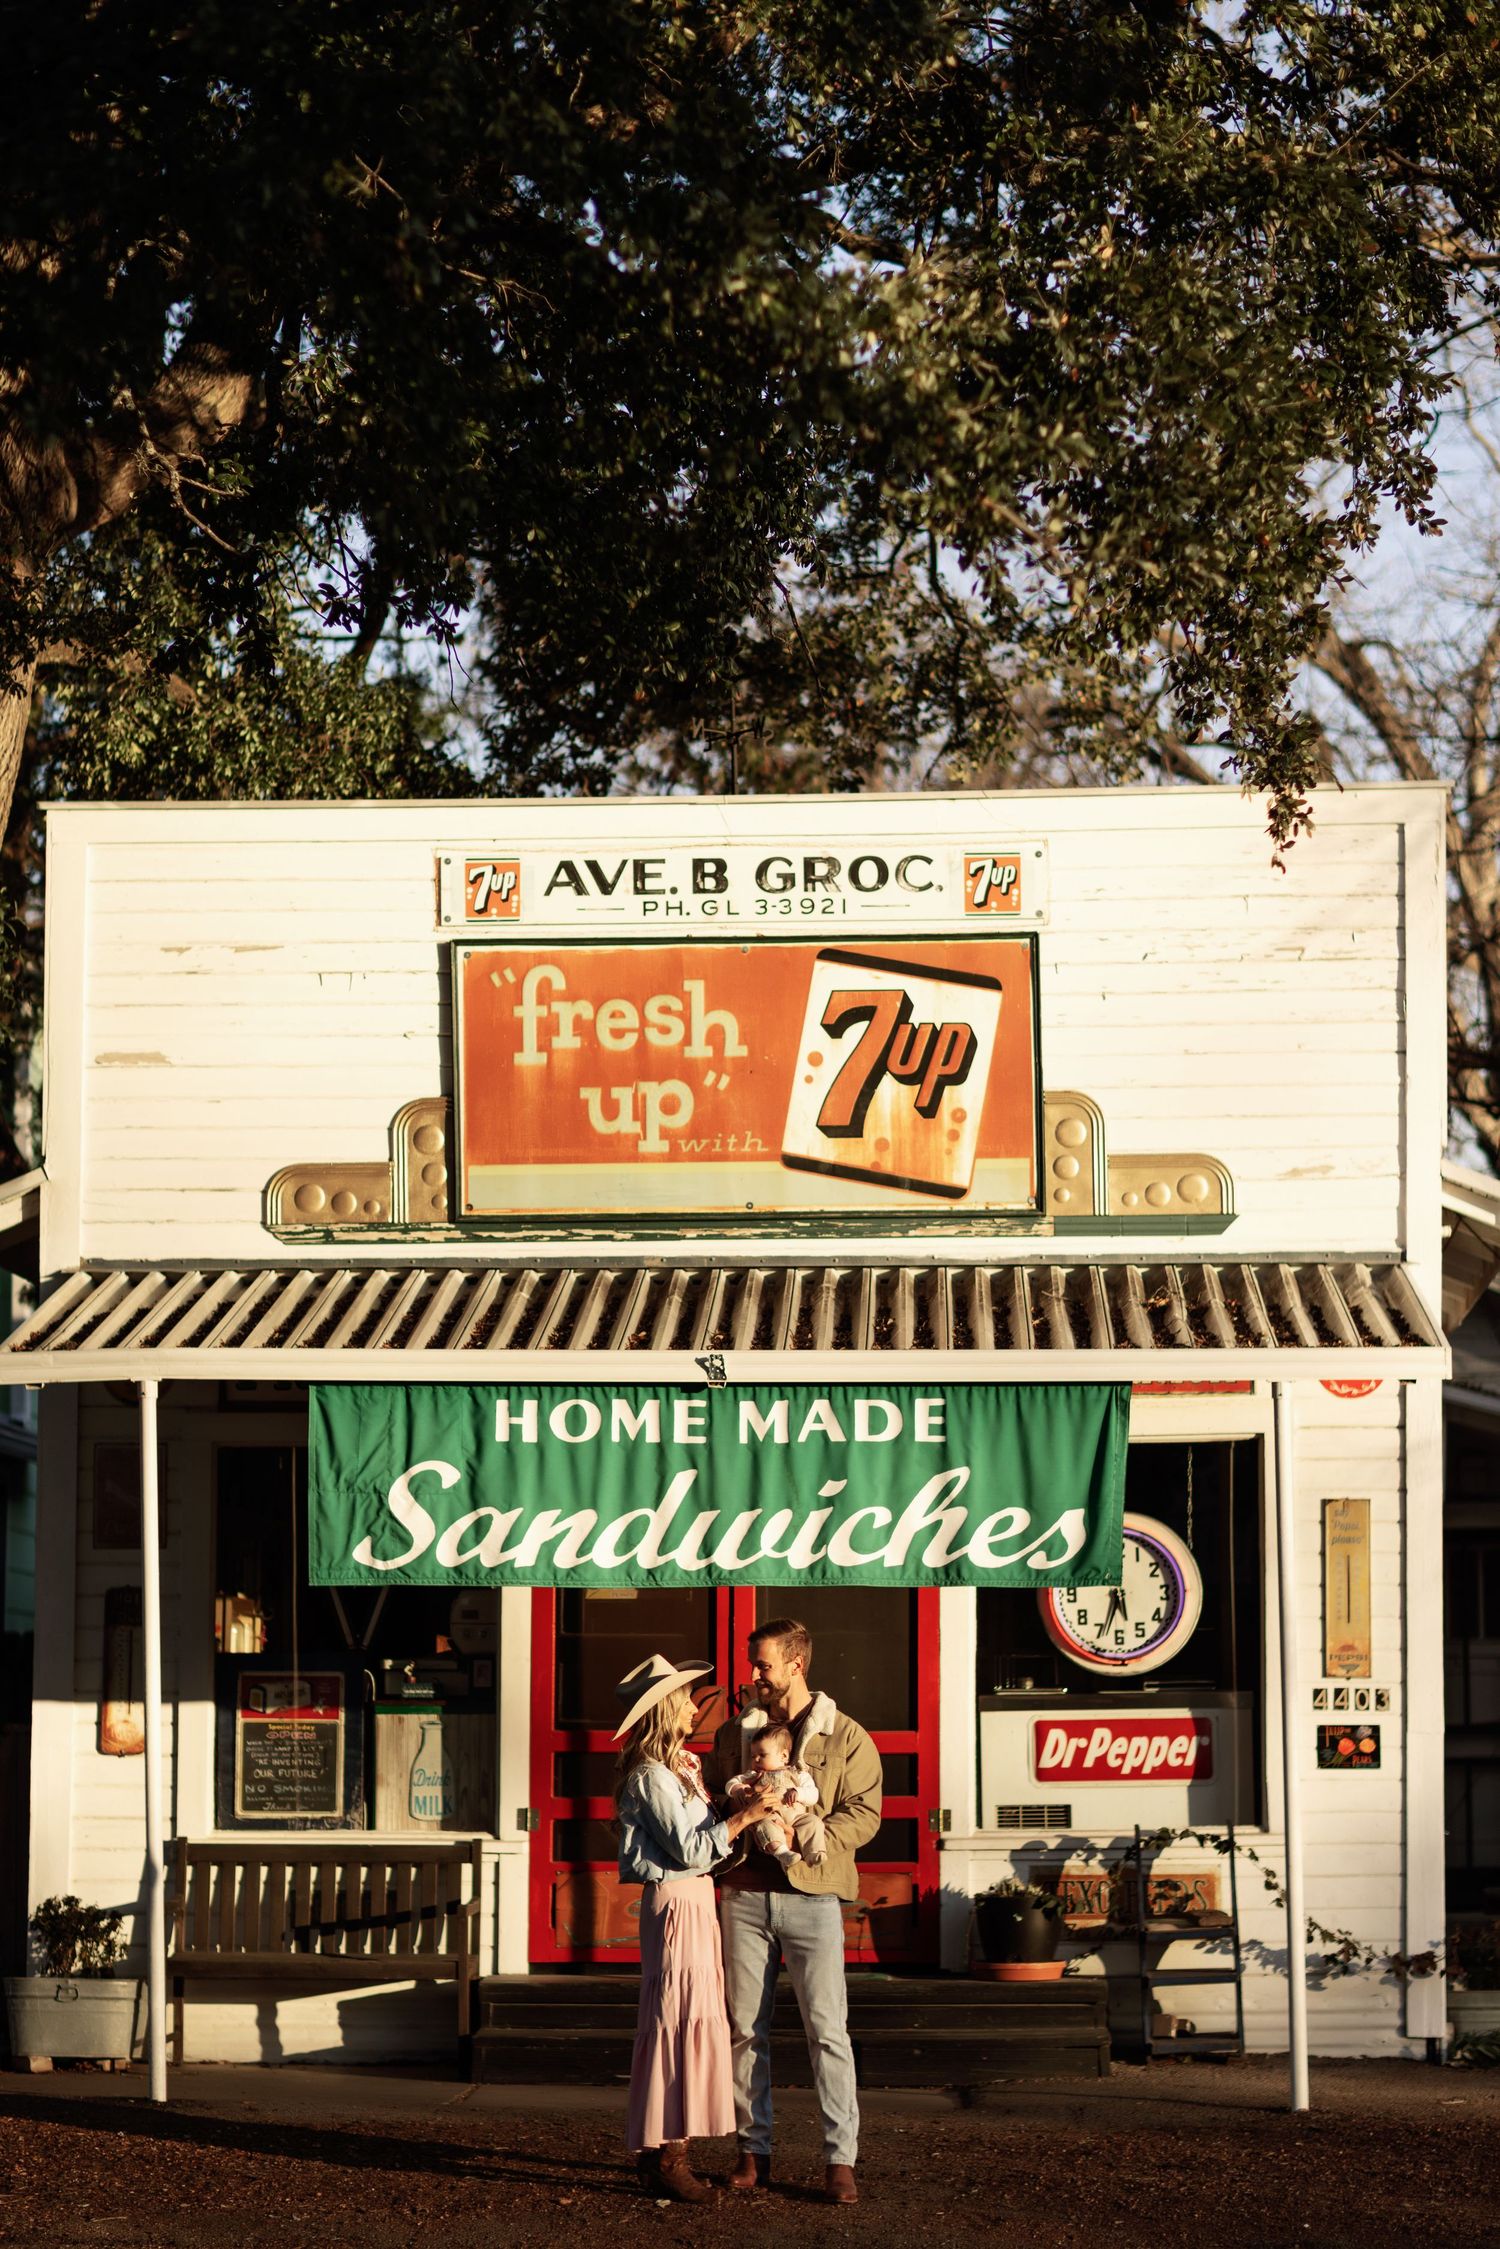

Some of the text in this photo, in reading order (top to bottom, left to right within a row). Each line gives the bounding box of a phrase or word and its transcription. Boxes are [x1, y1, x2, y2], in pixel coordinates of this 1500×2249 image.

[755, 855, 944, 894] GROC.
[643, 898, 847, 916] PH. GL 3-3921
[678, 1130, 769, 1152] with
[495, 1398, 946, 1443] HOME MADE
[352, 1460, 1087, 1571] Sandwiches
[1149, 1562, 1159, 1578] 2
[1160, 1584, 1169, 1601] 3
[1077, 1609, 1088, 1625] 8
[1151, 1608, 1162, 1623] 4
[1094, 1623, 1104, 1639] 7
[1114, 1630, 1125, 1645] 6
[1135, 1622, 1146, 1638] 5
[1313, 1688, 1390, 1711] 4403
[265, 1731, 317, 1740] OPEN
[253, 1768, 274, 1779] OUR
[413, 1768, 450, 1787] Drink
[244, 1784, 267, 1794] NO
[414, 1794, 453, 1816] MILK
